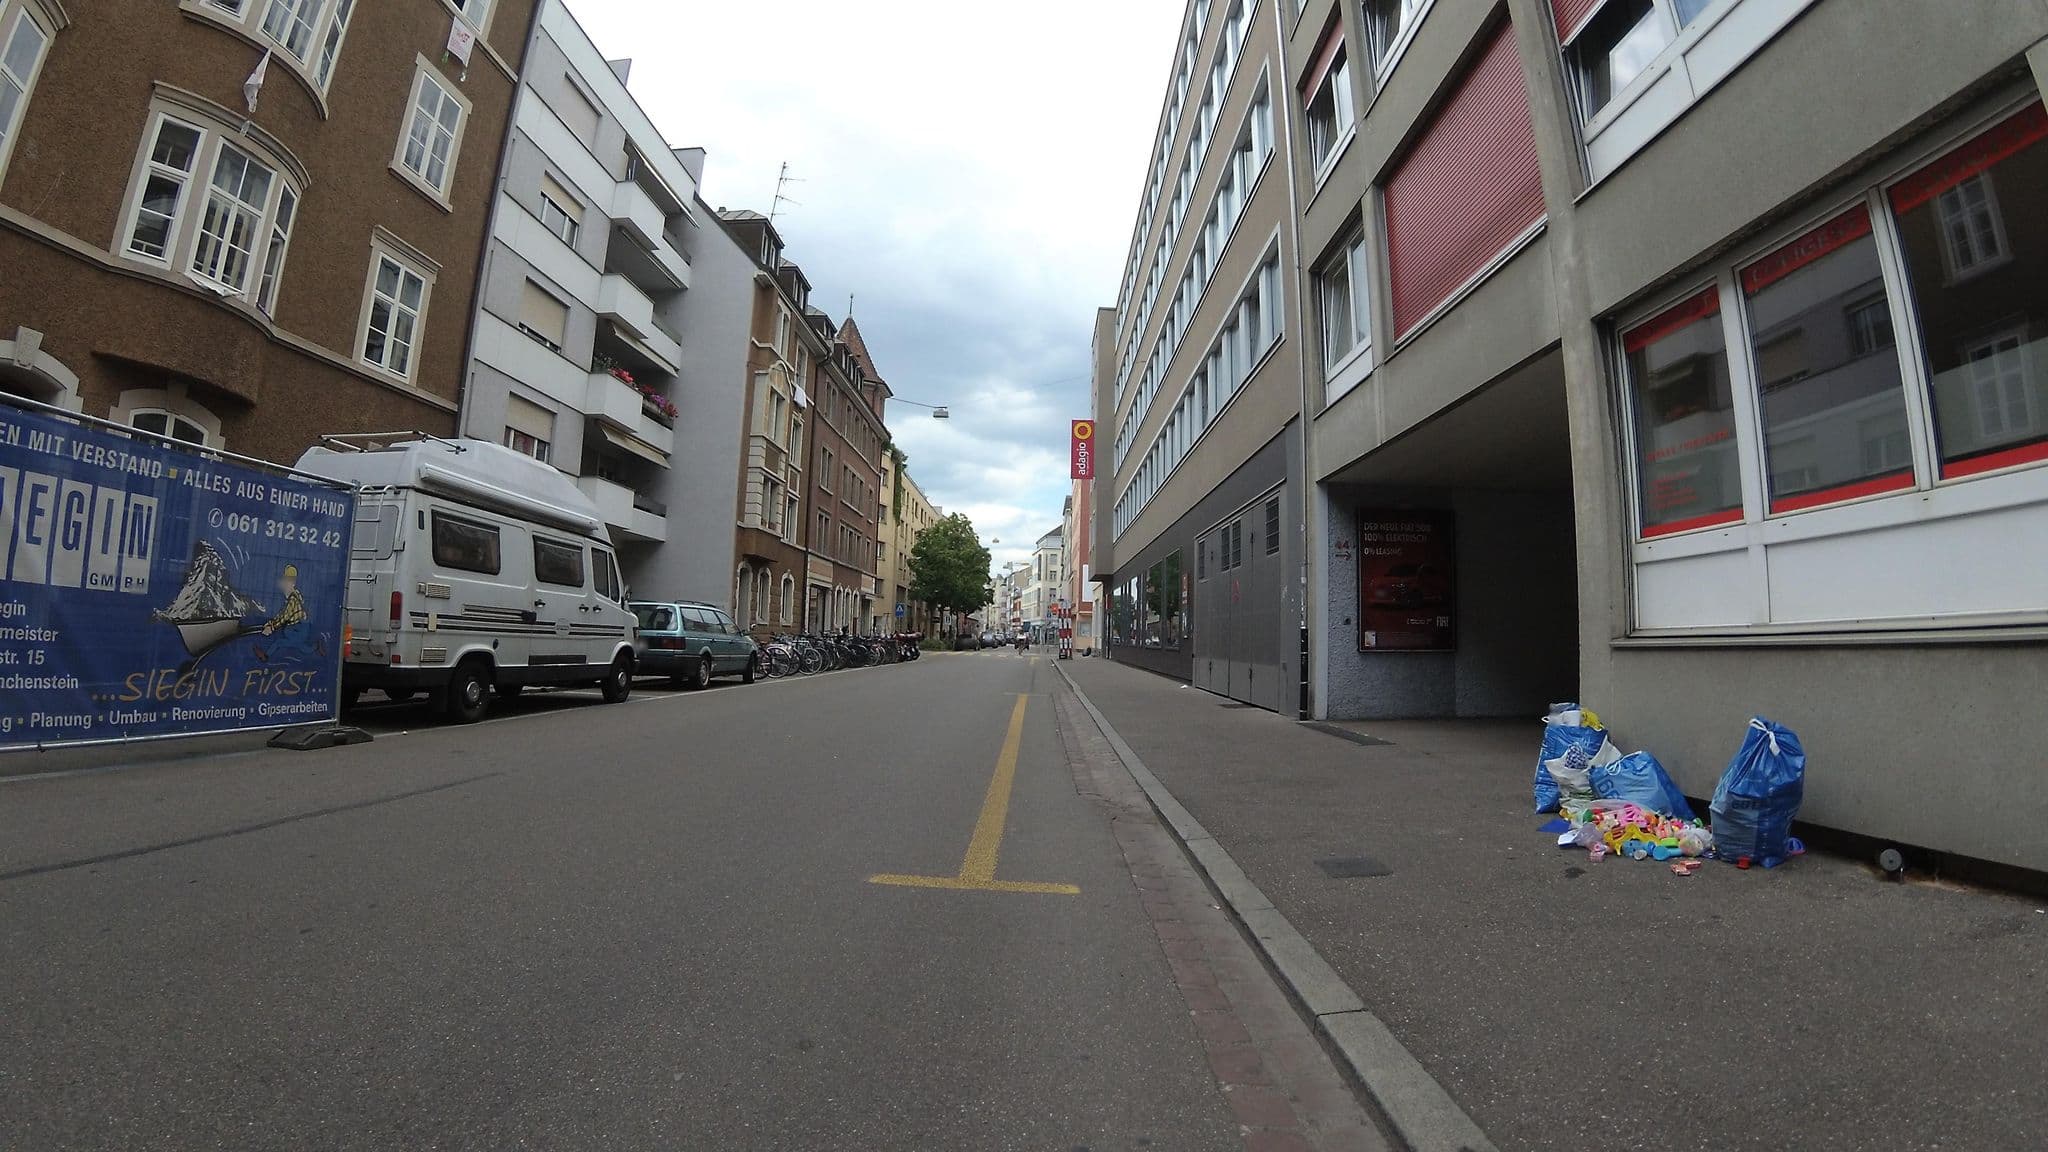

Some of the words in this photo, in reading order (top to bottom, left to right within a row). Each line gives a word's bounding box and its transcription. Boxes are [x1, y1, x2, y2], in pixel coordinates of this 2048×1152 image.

[28, 429, 65, 456] MIT
[71, 439, 162, 480] VERSTAND
[182, 468, 232, 495] ALLES
[236, 480, 265, 501] AUS
[269, 487, 308, 511] EINER
[312, 497, 346, 519] HAND
[1075, 442, 1089, 475] adagio
[227, 512, 259, 534] 061
[265, 519, 296, 540] 312
[299, 526, 318, 544] 32
[322, 530, 341, 548] 42
[89, 572, 145, 590] GMBH
[27, 649, 45, 665] 15
[30, 711, 93, 731] Planung
[108, 708, 157, 726] Umbau
[172, 705, 246, 721] Renovierung
[258, 702, 329, 718] Gipserarbeiten
